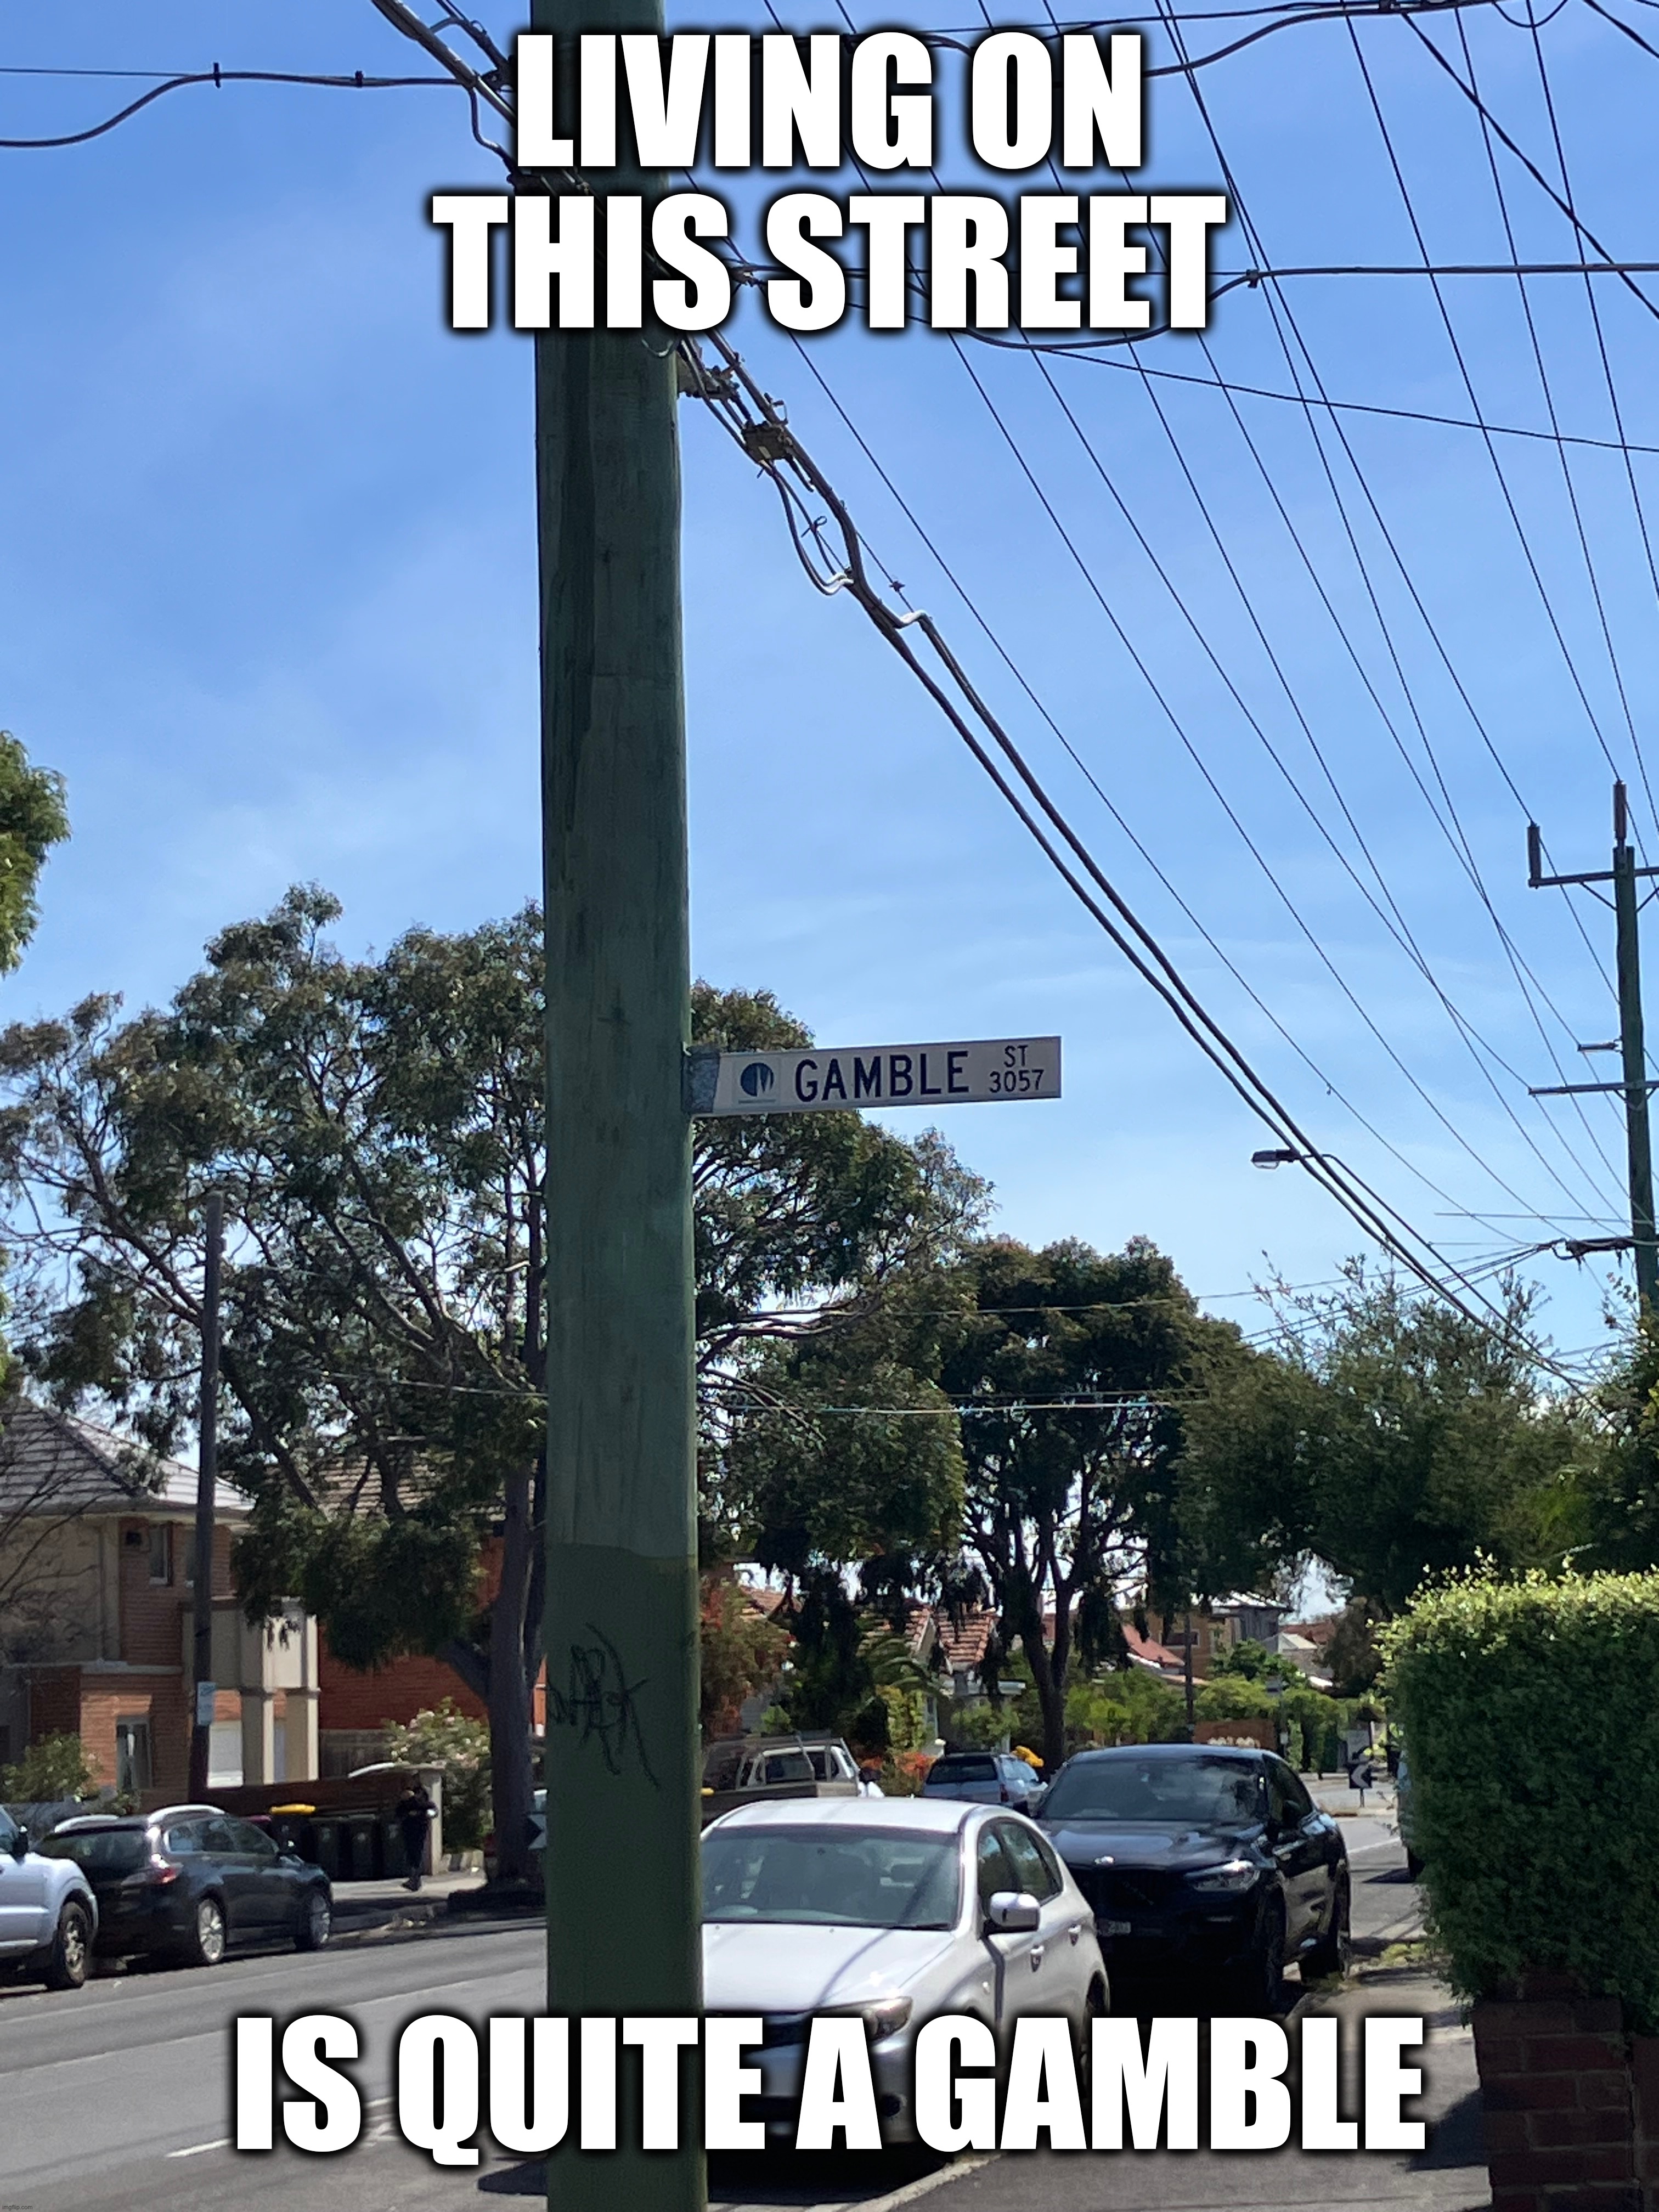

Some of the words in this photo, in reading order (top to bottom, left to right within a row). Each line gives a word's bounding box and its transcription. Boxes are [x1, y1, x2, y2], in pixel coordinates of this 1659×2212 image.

[1003, 1045, 1030, 1068] ST
[794, 1050, 970, 1102] GAMBLE
[989, 1069, 1045, 1093] 3057
